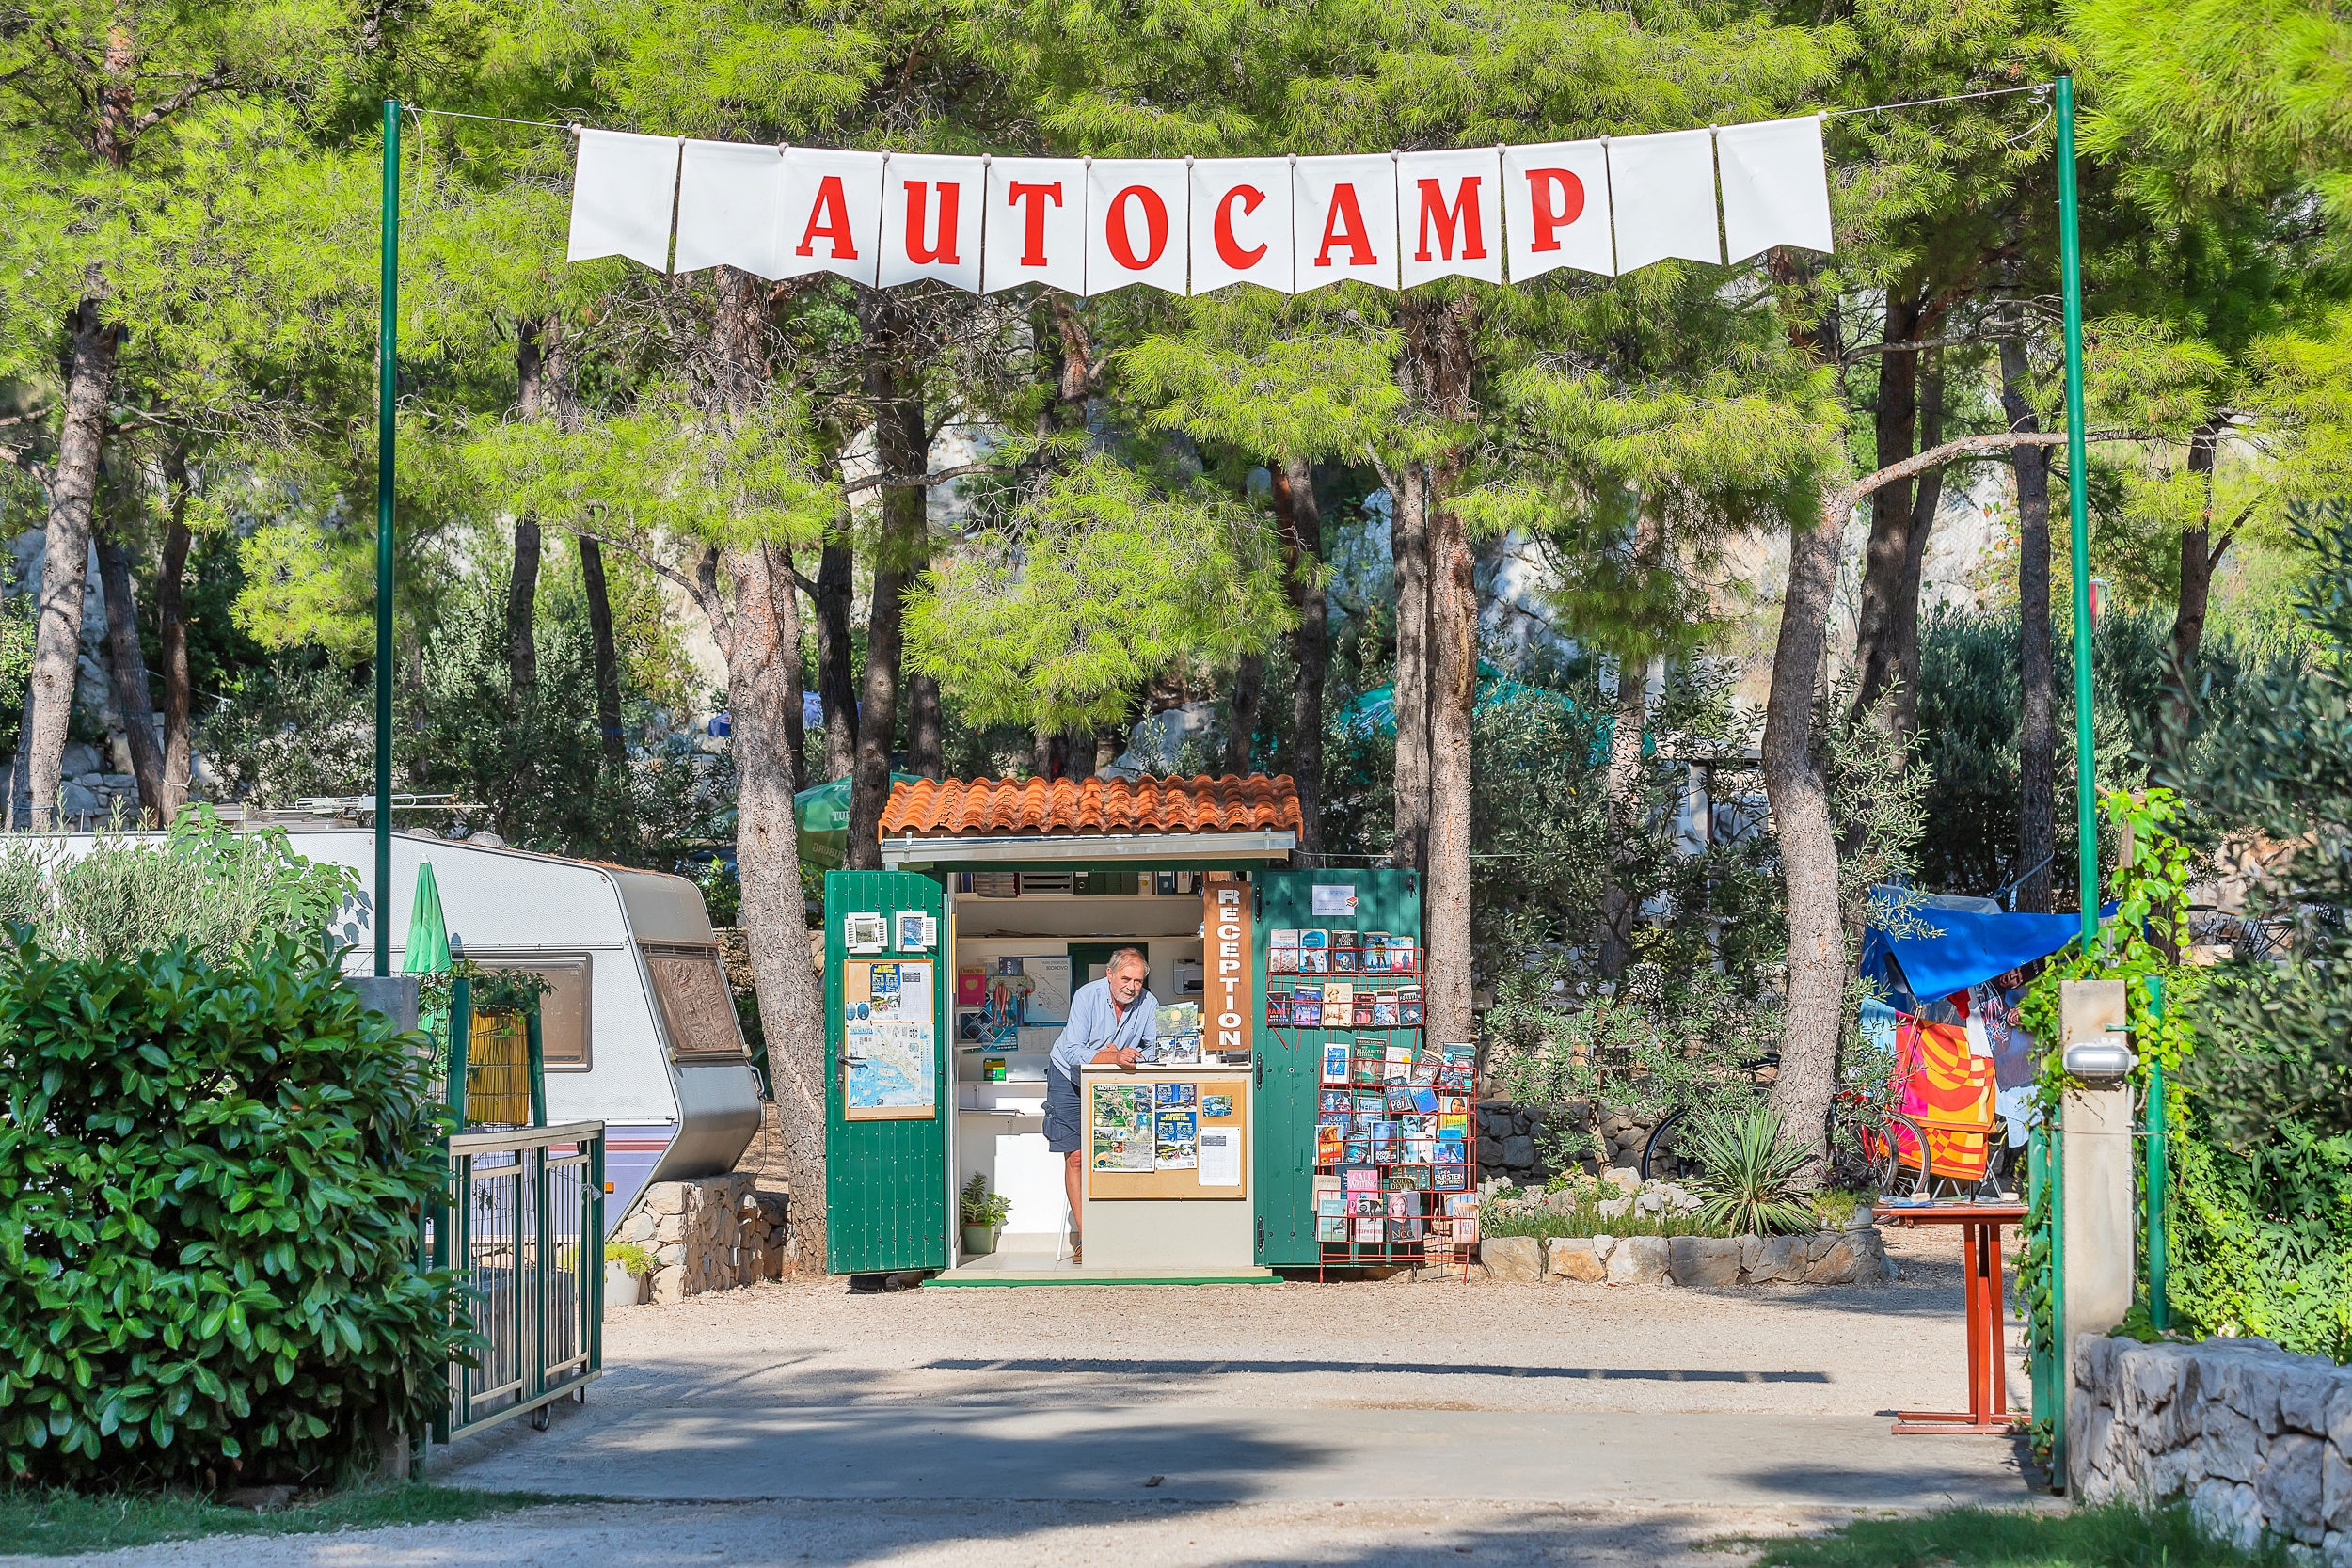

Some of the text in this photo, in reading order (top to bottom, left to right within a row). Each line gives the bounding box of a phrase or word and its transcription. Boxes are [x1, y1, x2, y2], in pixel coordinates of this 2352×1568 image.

[795, 167, 1586, 270] AUTOCAMP
[1217, 889, 1242, 1046] RECEPTION
[1352, 1173, 1372, 1181] CALL
